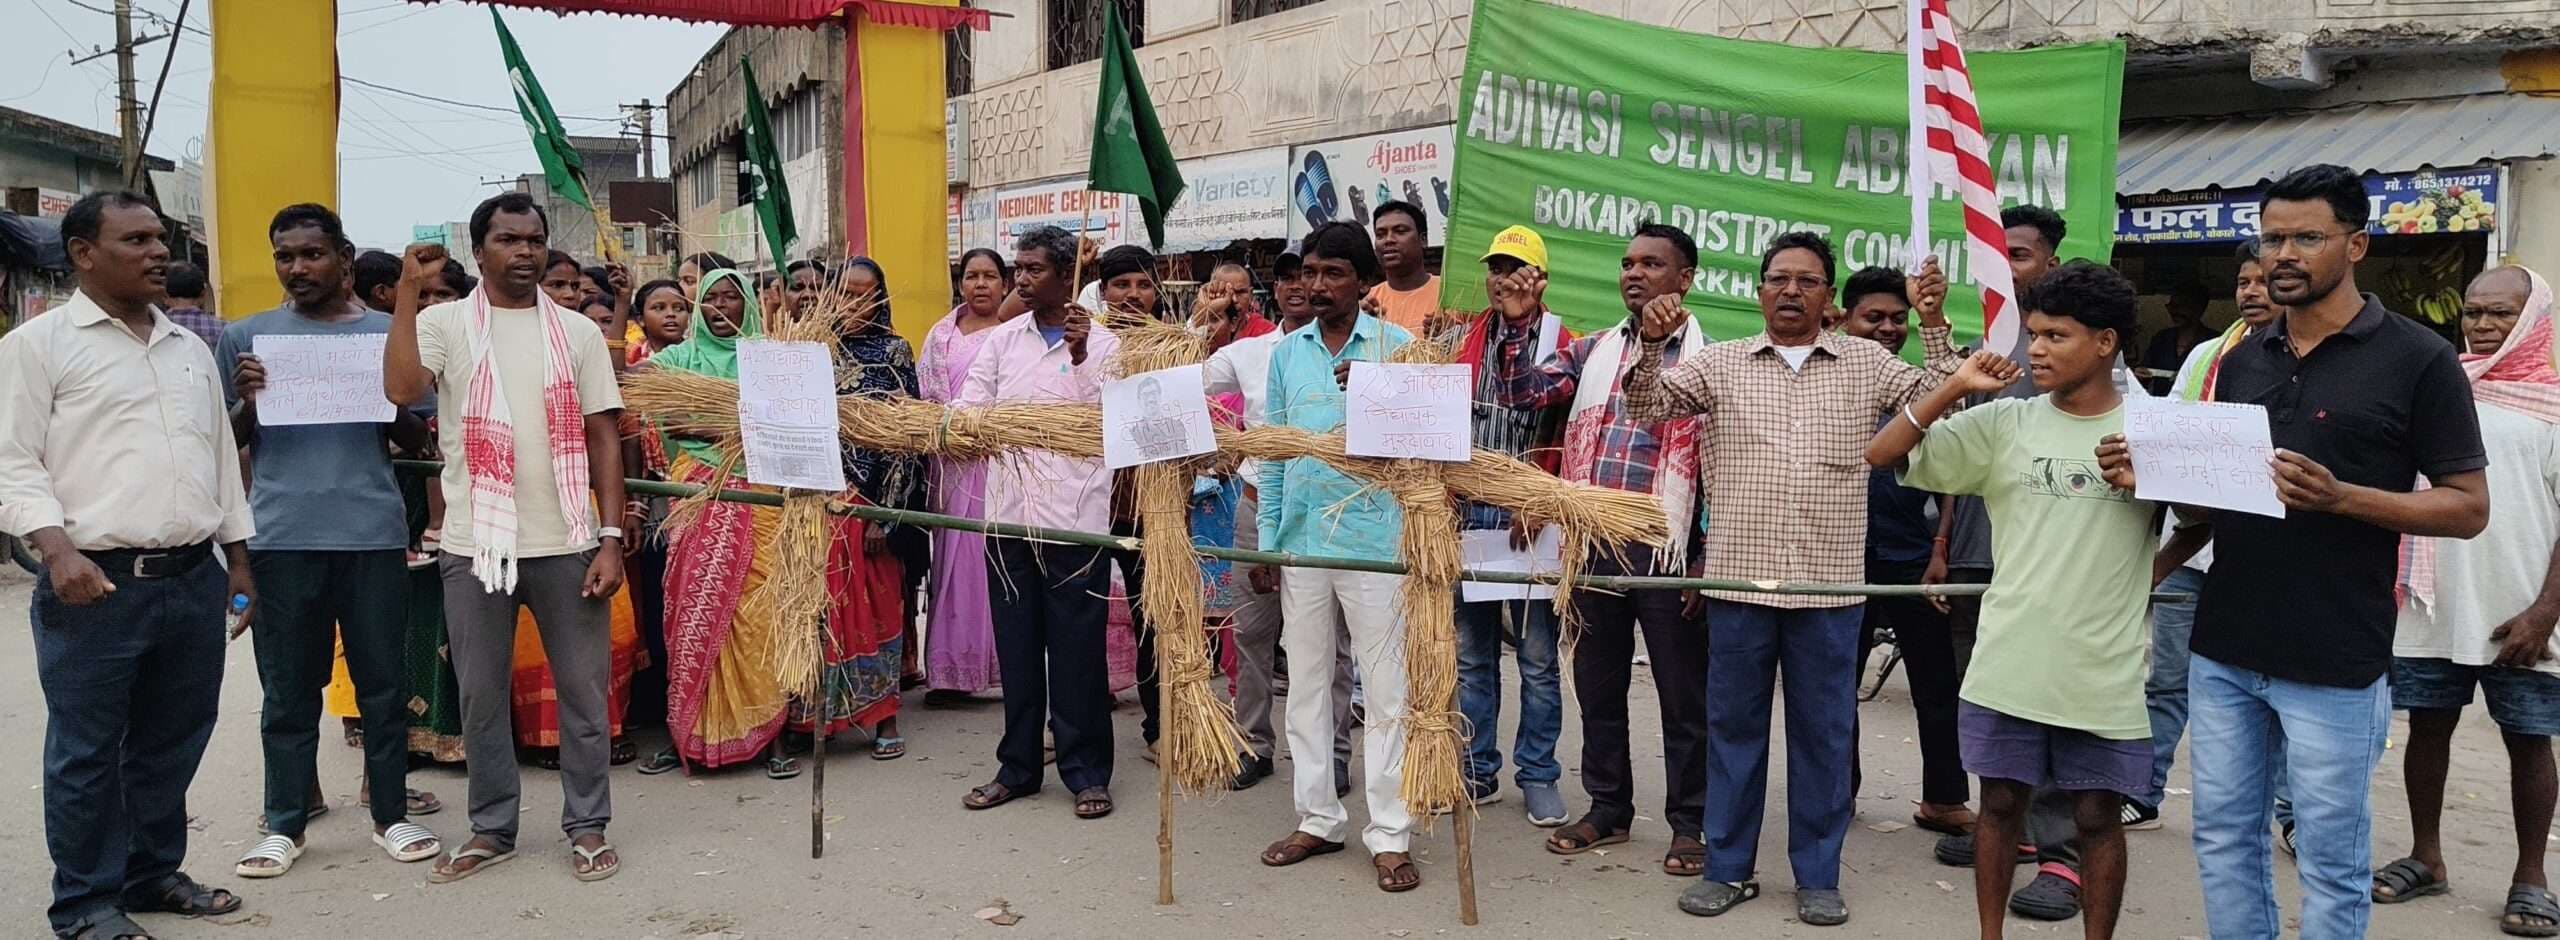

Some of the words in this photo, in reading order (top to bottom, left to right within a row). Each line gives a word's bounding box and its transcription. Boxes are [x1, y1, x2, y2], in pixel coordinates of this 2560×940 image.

[1466, 70, 1622, 158] ADIVASI
[1649, 101, 1813, 184] SENGEL
[1367, 139, 1437, 174] Ajanta
[1194, 173, 1276, 202] Variety
[998, 192, 1055, 220] MEDICINE
[2131, 203, 2224, 231] फल
